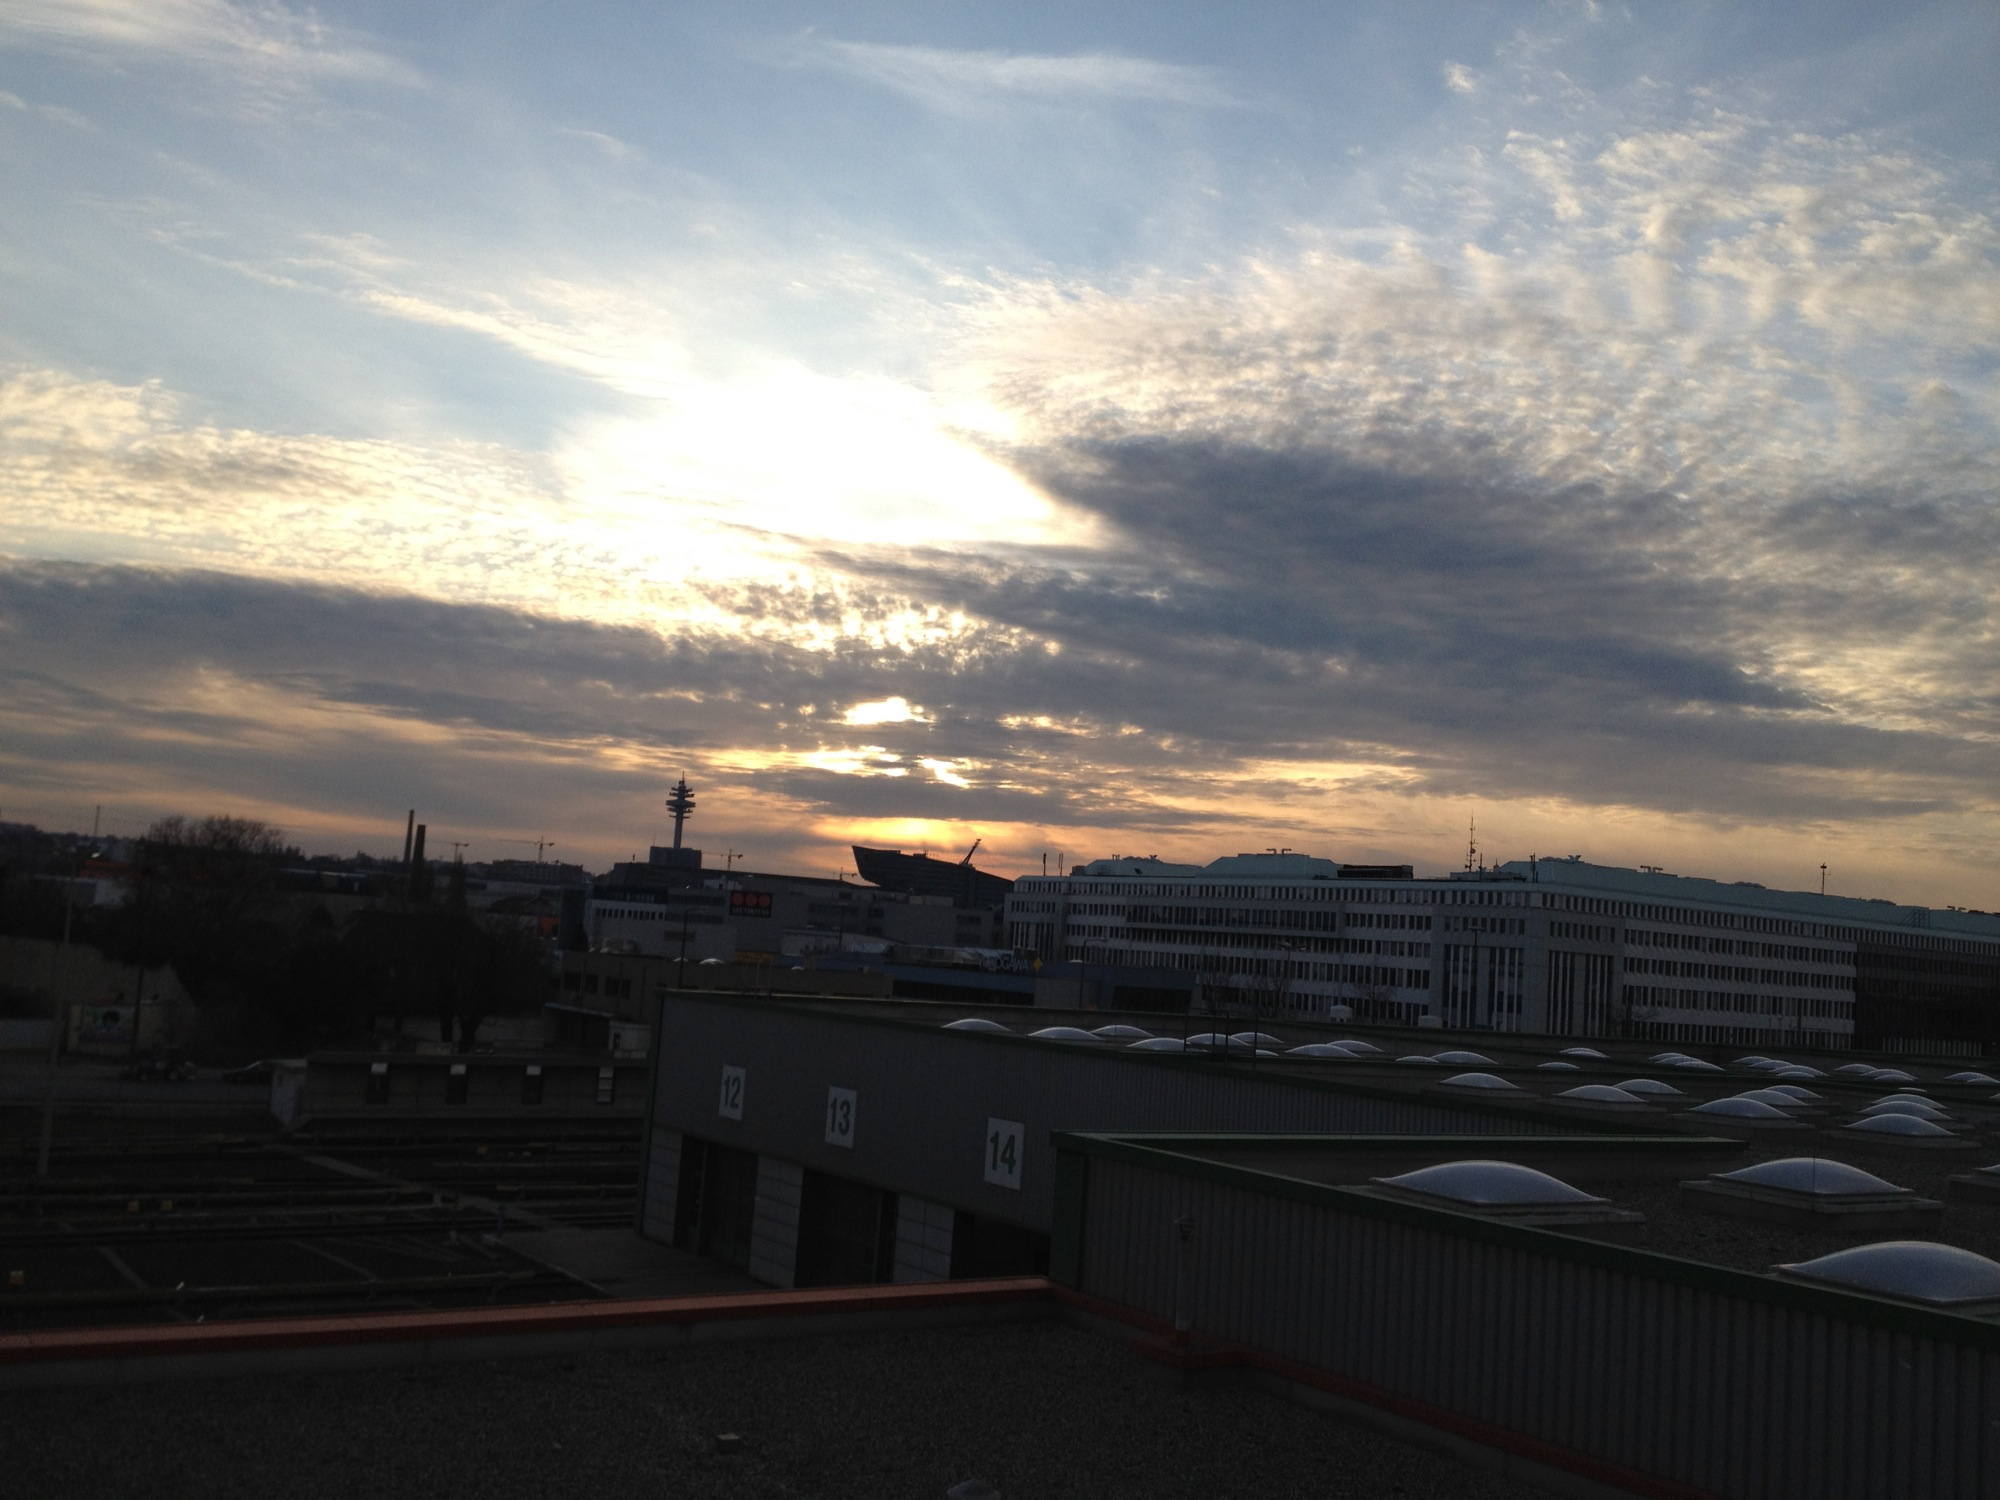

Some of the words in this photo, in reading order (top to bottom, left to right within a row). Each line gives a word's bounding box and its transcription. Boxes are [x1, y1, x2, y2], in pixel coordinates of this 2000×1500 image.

[723, 1075, 741, 1109] 12
[830, 1098, 851, 1135] 13
[990, 1130, 1016, 1174] 14
